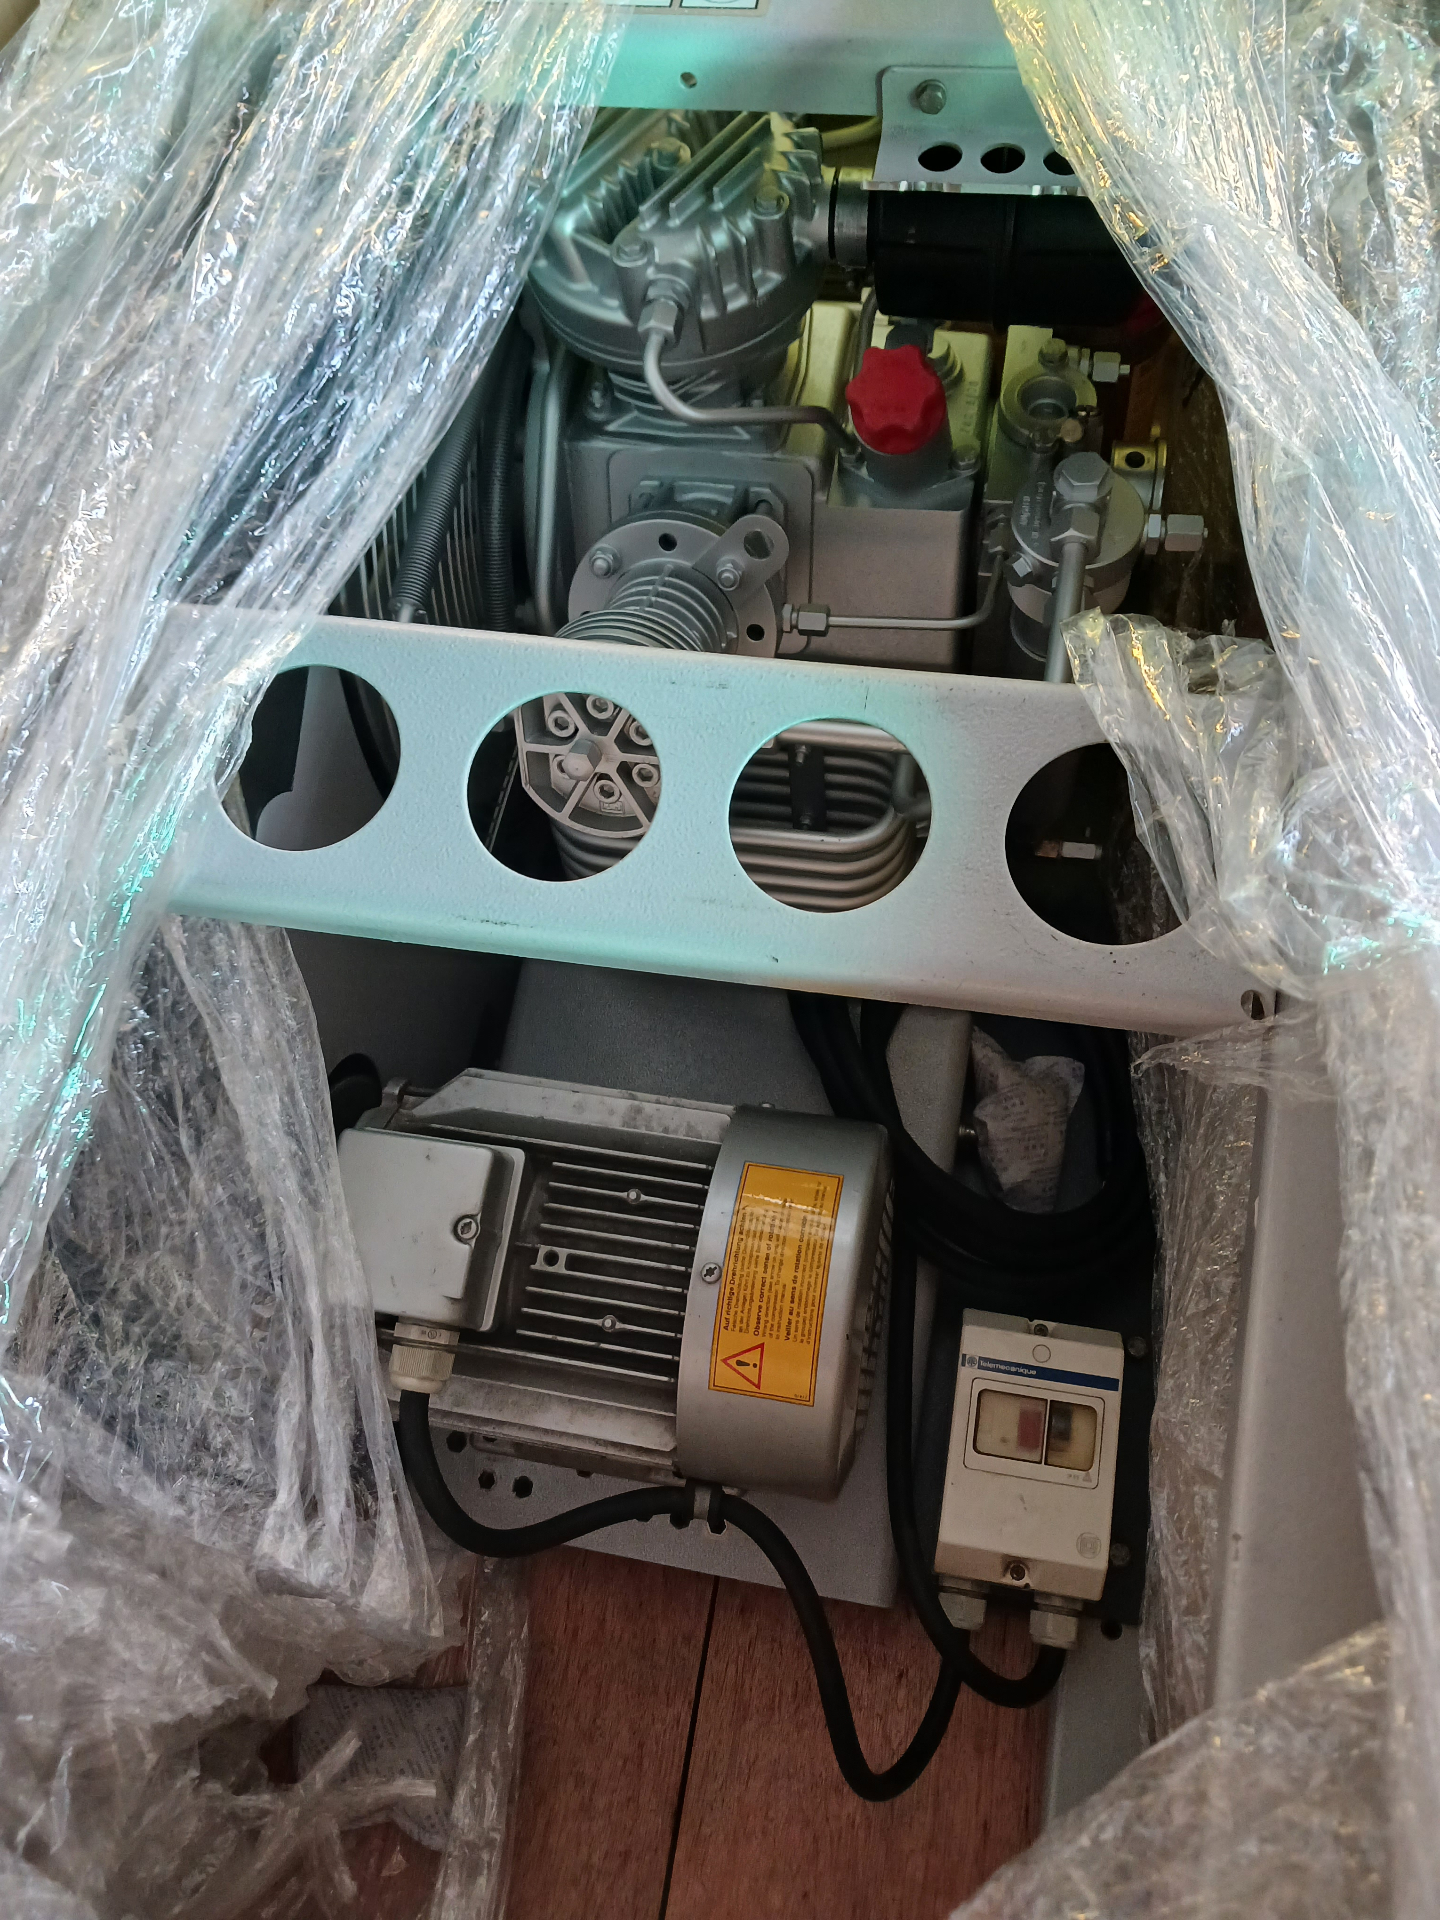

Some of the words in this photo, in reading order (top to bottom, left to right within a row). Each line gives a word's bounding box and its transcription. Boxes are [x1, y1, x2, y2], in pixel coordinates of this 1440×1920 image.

[737, 1211, 747, 1235] achten
[764, 1242, 772, 1251] of
[728, 1236, 743, 1285] Drehrichtung
[793, 1244, 803, 1273] rotation
[756, 1275, 767, 1303] correct
[790, 1274, 798, 1285] de
[723, 1285, 735, 1316] richtige
[788, 1285, 797, 1305] sens
[752, 1303, 763, 1337] Observe
[787, 1305, 794, 1316] au
[722, 1316, 730, 1331] Auf
[980, 1360, 1037, 1375] Telemecanique
